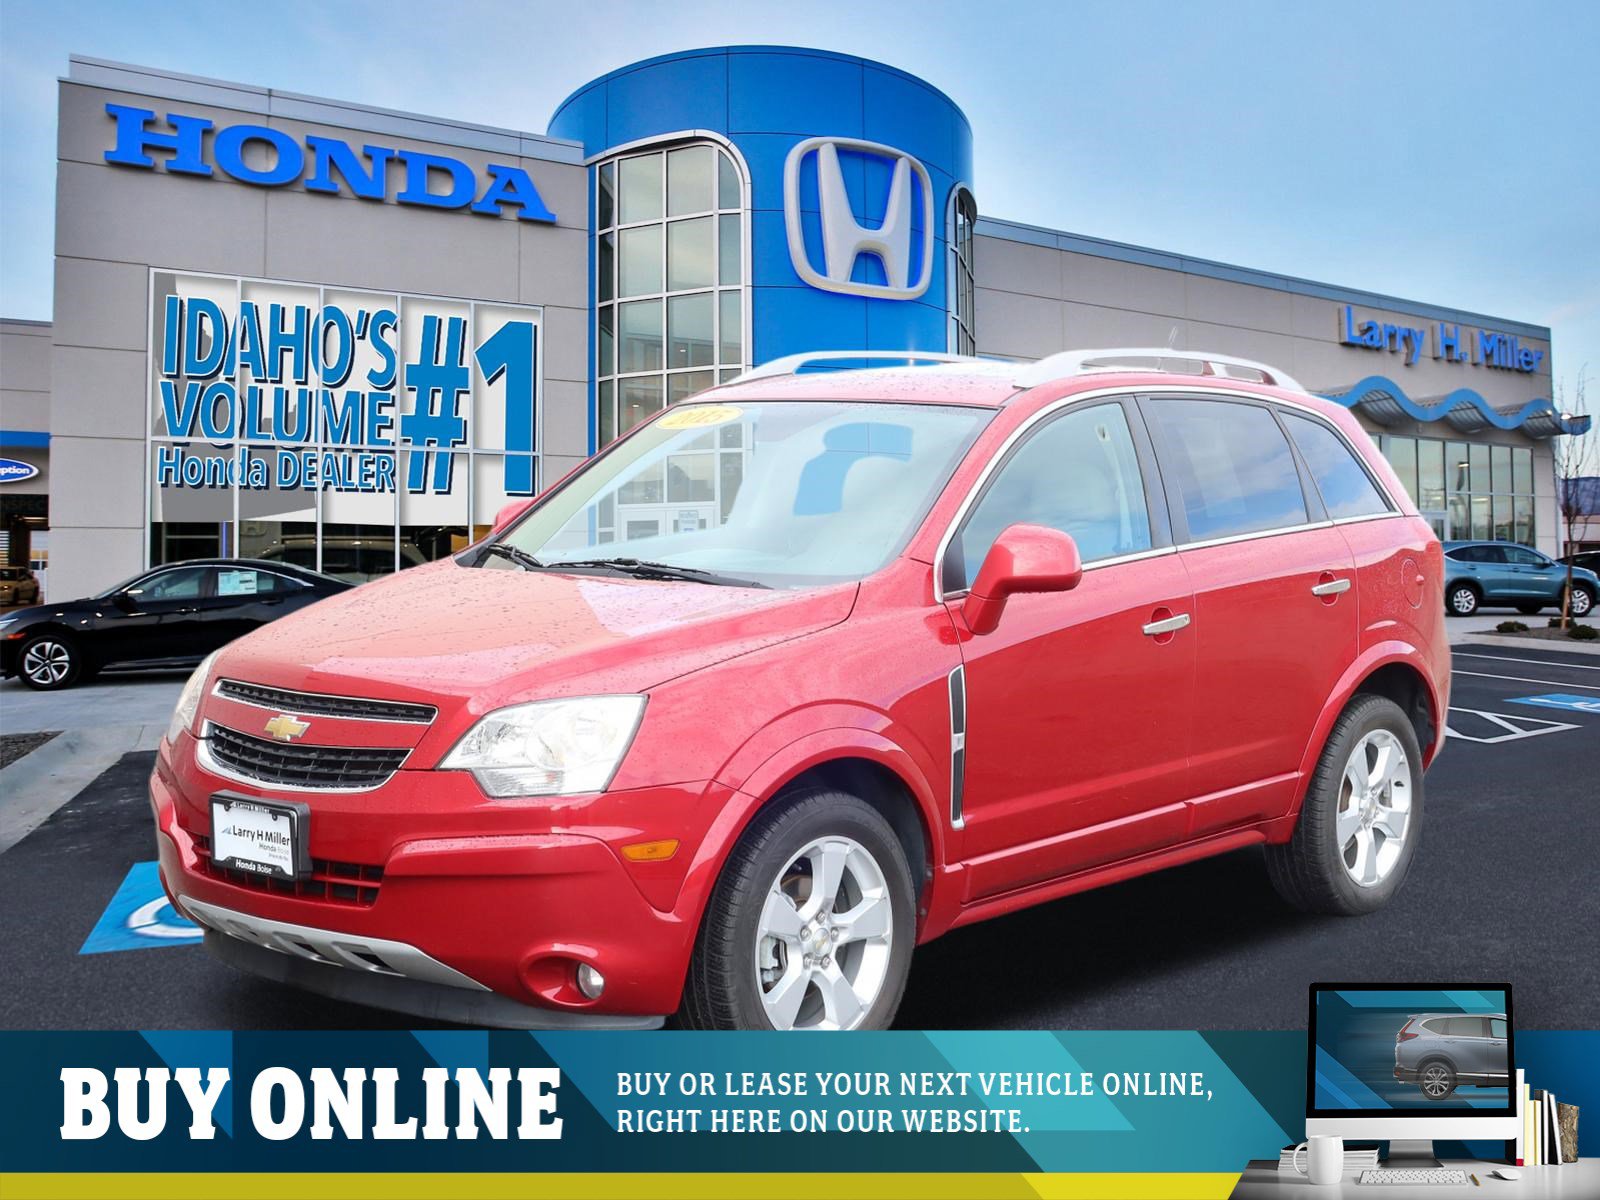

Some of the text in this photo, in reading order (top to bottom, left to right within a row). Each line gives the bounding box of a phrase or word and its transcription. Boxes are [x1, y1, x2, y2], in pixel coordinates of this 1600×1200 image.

[104, 103, 557, 223] HONDA
[162, 295, 398, 388] IDAHO'S
[1343, 306, 1544, 371] Larry H. Miller
[159, 380, 395, 449] VOLUME
[401, 315, 537, 496] #1
[0, 466, 30, 476] ption
[157, 446, 396, 492] Honda DEALER
[233, 825, 290, 846] Larry H Miller
[236, 859, 272, 875] Honda Boise
